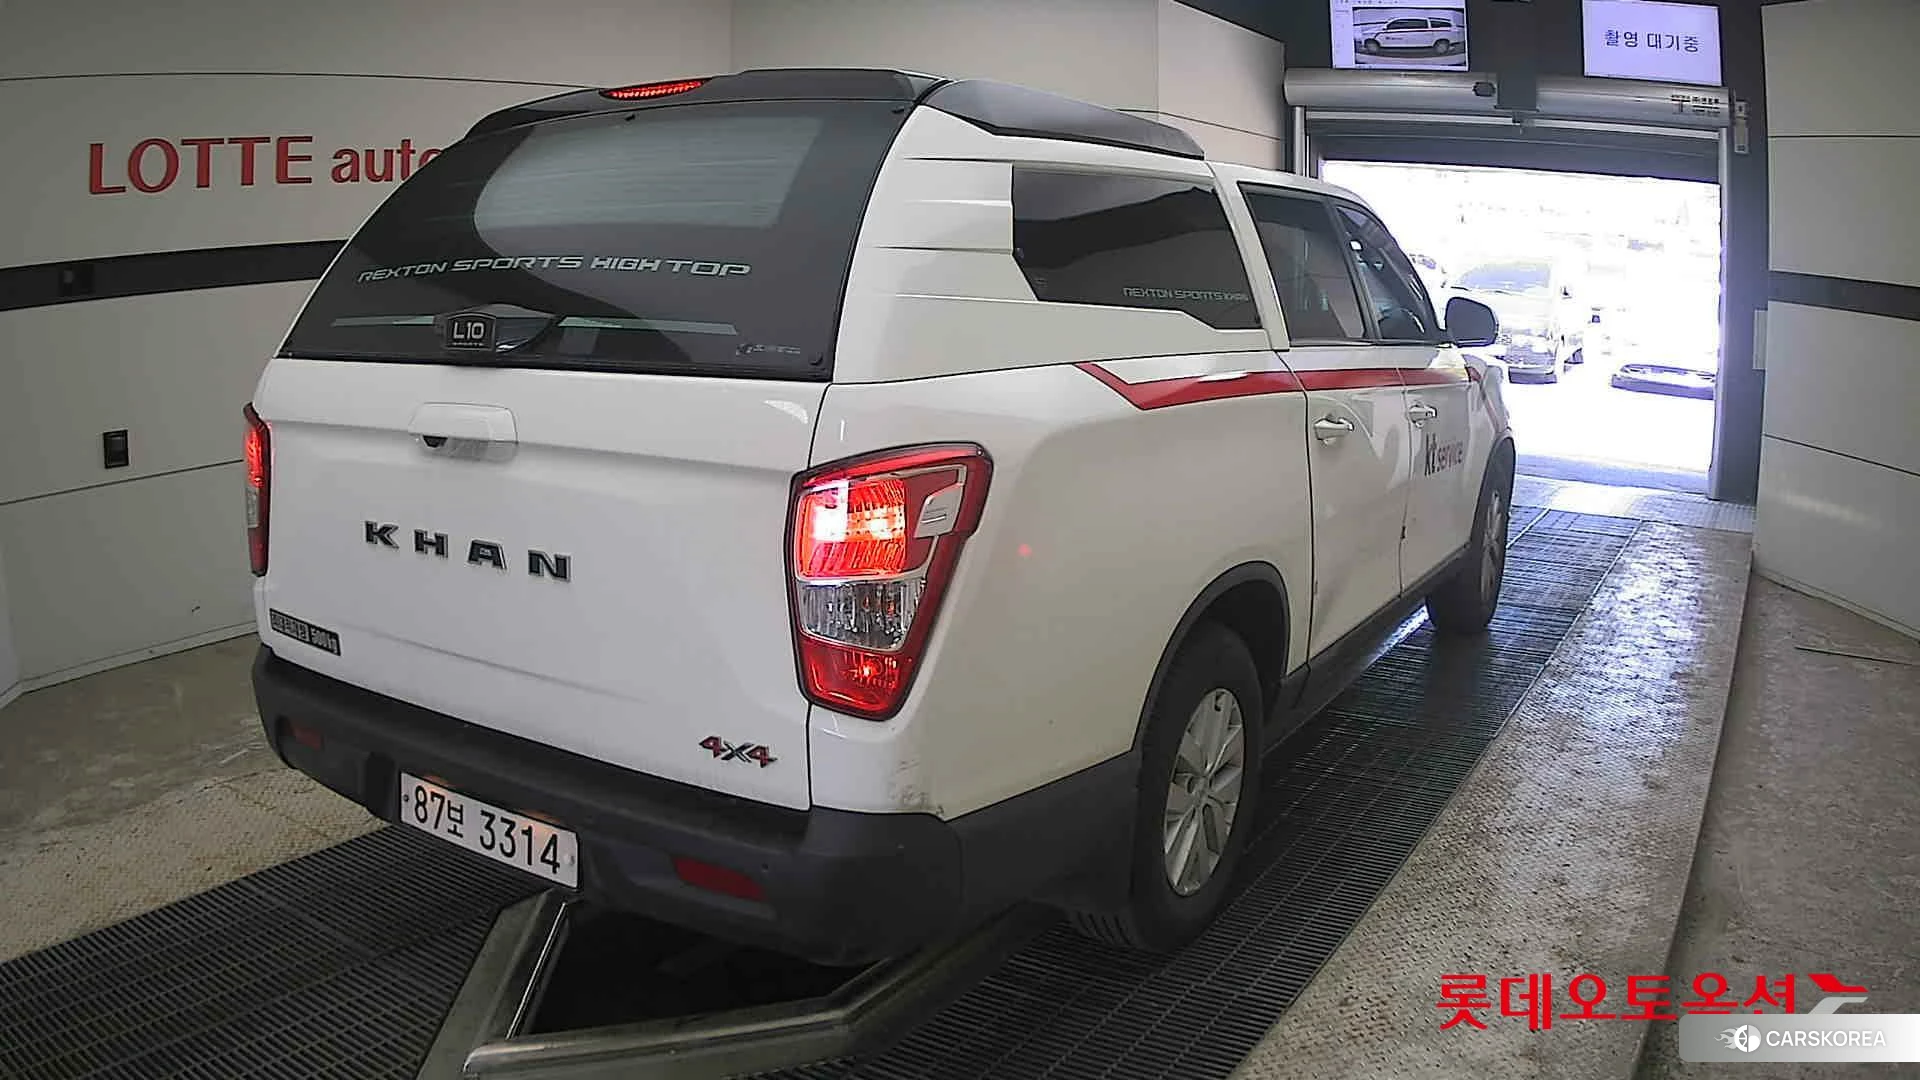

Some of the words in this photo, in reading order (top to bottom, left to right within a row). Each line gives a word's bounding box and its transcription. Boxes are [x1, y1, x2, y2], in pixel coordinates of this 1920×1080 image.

[1605, 29, 1638, 48] 촬영
[1647, 33, 1698, 53] 대기중
[88, 135, 313, 195] LOTTE
[357, 262, 448, 283] REXTON
[451, 255, 584, 272] SPORTS
[590, 256, 662, 272] HIGH
[665, 259, 751, 277] TOP
[453, 321, 485, 340] L10
[363, 520, 572, 584] KHAN
[414, 785, 464, 839] 87보
[479, 809, 560, 875] 3314
